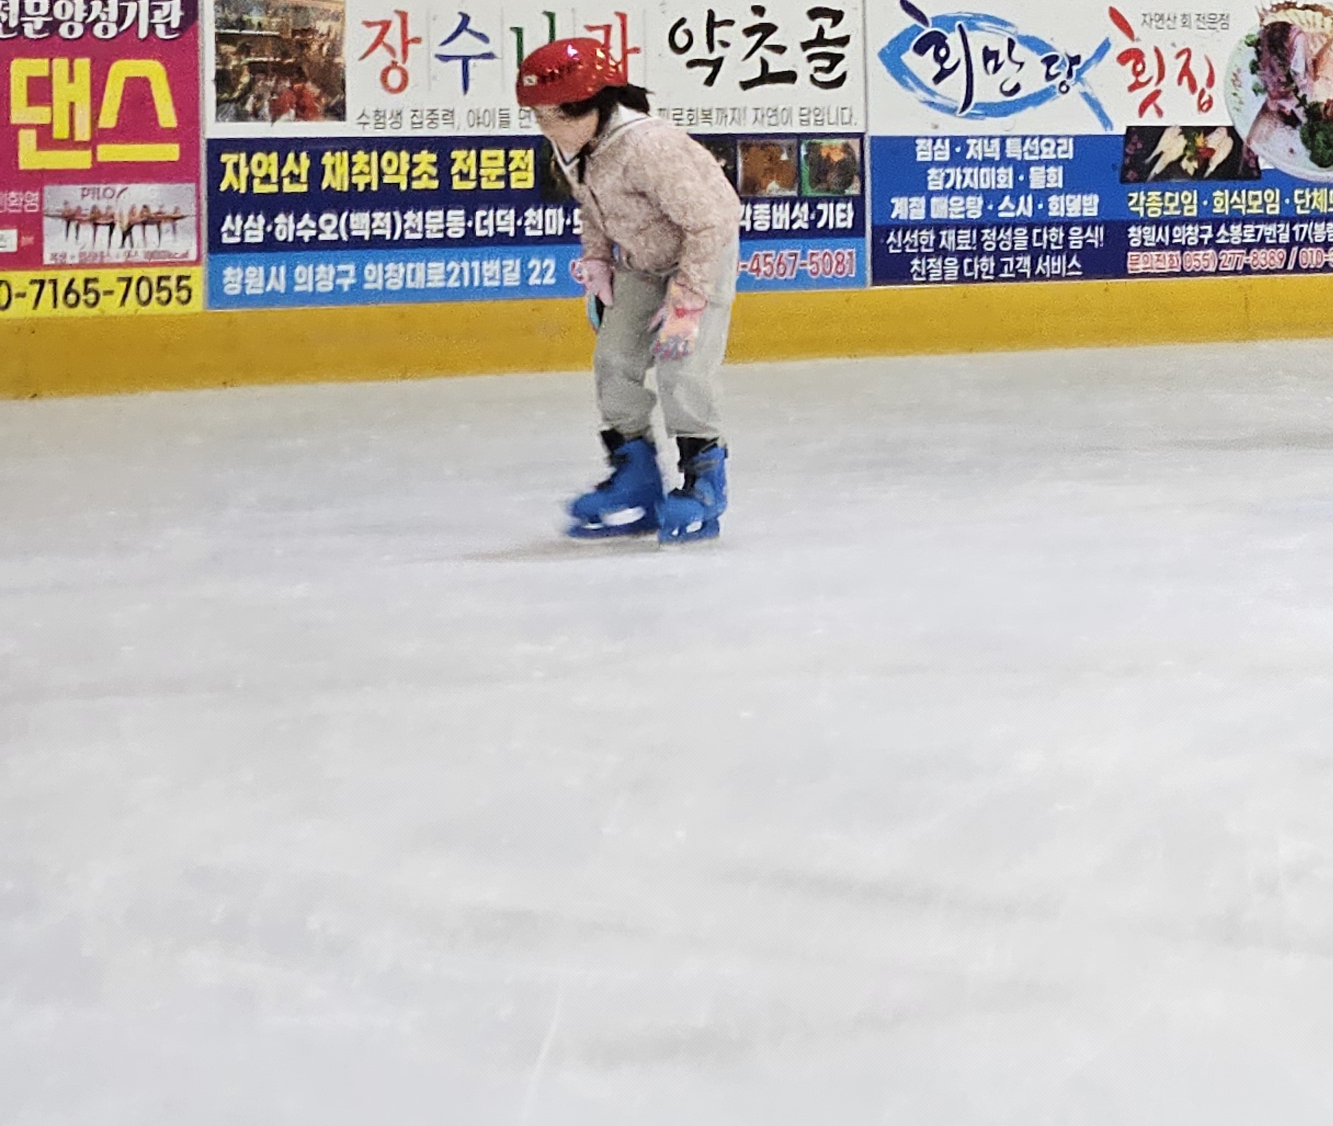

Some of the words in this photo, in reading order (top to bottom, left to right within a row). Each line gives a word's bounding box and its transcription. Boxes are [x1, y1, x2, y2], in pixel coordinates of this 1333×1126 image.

[1141, 12, 1178, 30] 자연산
[1181, 13, 1193, 29] 회
[1195, 12, 1231, 31] 전문점
[668, 5, 850, 91] 약초골
[1109, 6, 1216, 118] 횟집
[10, 58, 180, 170] 댄스
[356, 107, 402, 130] 수험생
[410, 107, 460, 131] 집중력,
[467, 107, 511, 129] 아이들
[752, 105, 793, 127] 자연이
[798, 105, 858, 127] 답입니다.
[915, 138, 950, 162] 점심
[966, 137, 1000, 160] 저녁
[1005, 137, 1074, 160] 특선요리
[220, 151, 310, 194] 자연산
[321, 149, 440, 193] 채취약초
[450, 148, 536, 191] 전문점
[1029, 165, 1064, 189] 물회
[0, 190, 40, 213] 환영
[890, 196, 926, 220] 계절
[930, 195, 983, 219] 매운탕
[997, 193, 1033, 218] 스시
[1047, 192, 1100, 217] 회덮밥
[1128, 189, 1198, 217] 각종모임
[1212, 188, 1280, 215] 회식모임
[886, 227, 935, 253] 신선한
[939, 227, 977, 252] 재료!
[980, 226, 1029, 251] 정성을
[1032, 226, 1065, 249] 다한
[1068, 224, 1104, 249] 음식!
[1127, 223, 1169, 247] 창원시
[1172, 223, 1214, 245] 의창구
[737, 248, 857, 280] -4567-5081
[910, 255, 959, 281] 친절을
[963, 254, 995, 280] 다한
[998, 254, 1031, 278] 고객
[1035, 252, 1083, 277] 서비스
[1127, 250, 1181, 273] 문의전화
[222, 264, 286, 295] 창원시
[294, 262, 357, 293] 의창구
[364, 259, 521, 291] 의창대로211번길
[528, 259, 556, 285] 22
